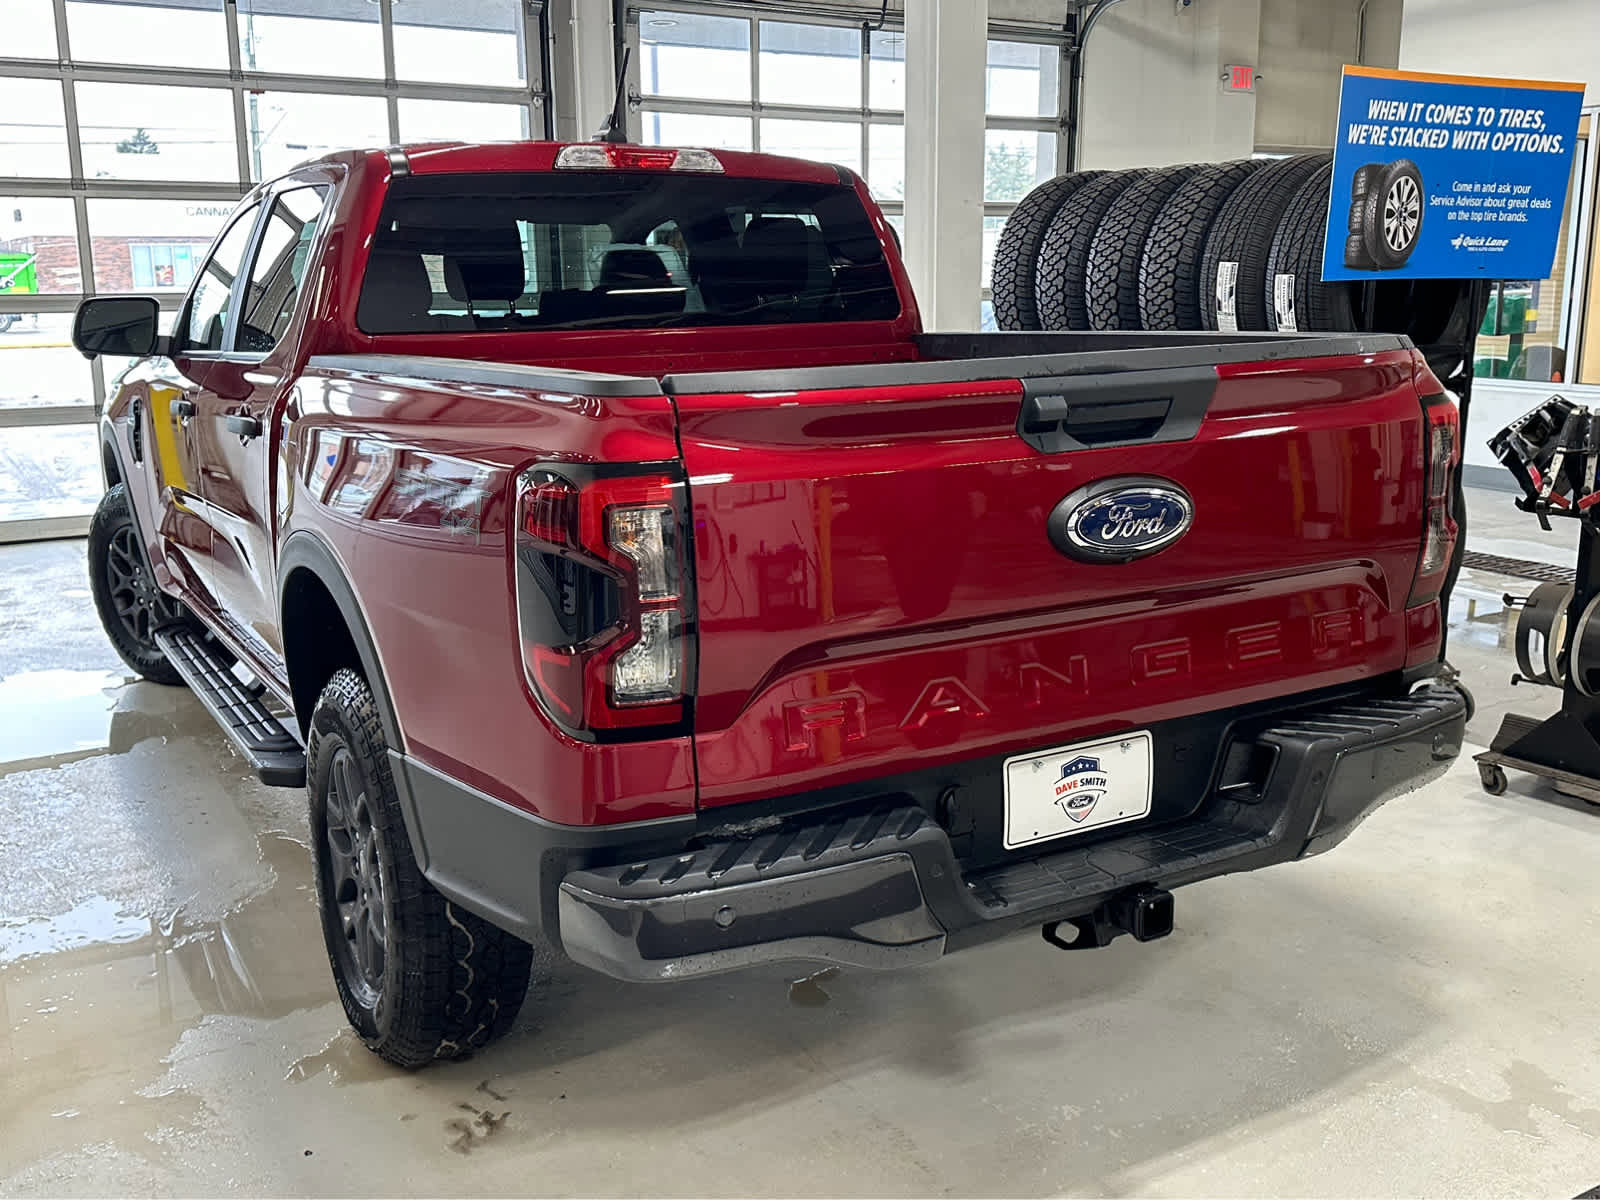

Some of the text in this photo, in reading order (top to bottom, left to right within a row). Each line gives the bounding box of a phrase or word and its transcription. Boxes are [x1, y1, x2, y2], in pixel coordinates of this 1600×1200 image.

[1368, 99, 1546, 131] WHEN IT COMES TO TIRES,
[1347, 123, 1564, 153] WE'RE STACKED WITH OPTIONS.
[1453, 181, 1531, 195] Come in and ask your
[1430, 195, 1552, 209] Service Advisor about great deals
[1447, 210, 1528, 222] on the top tire brands.
[1463, 236, 1509, 247] Quick Lane
[1101, 503, 1168, 540] Ford
[783, 606, 1365, 752] RANGER
[1056, 778, 1106, 795] DAVE SMITH
